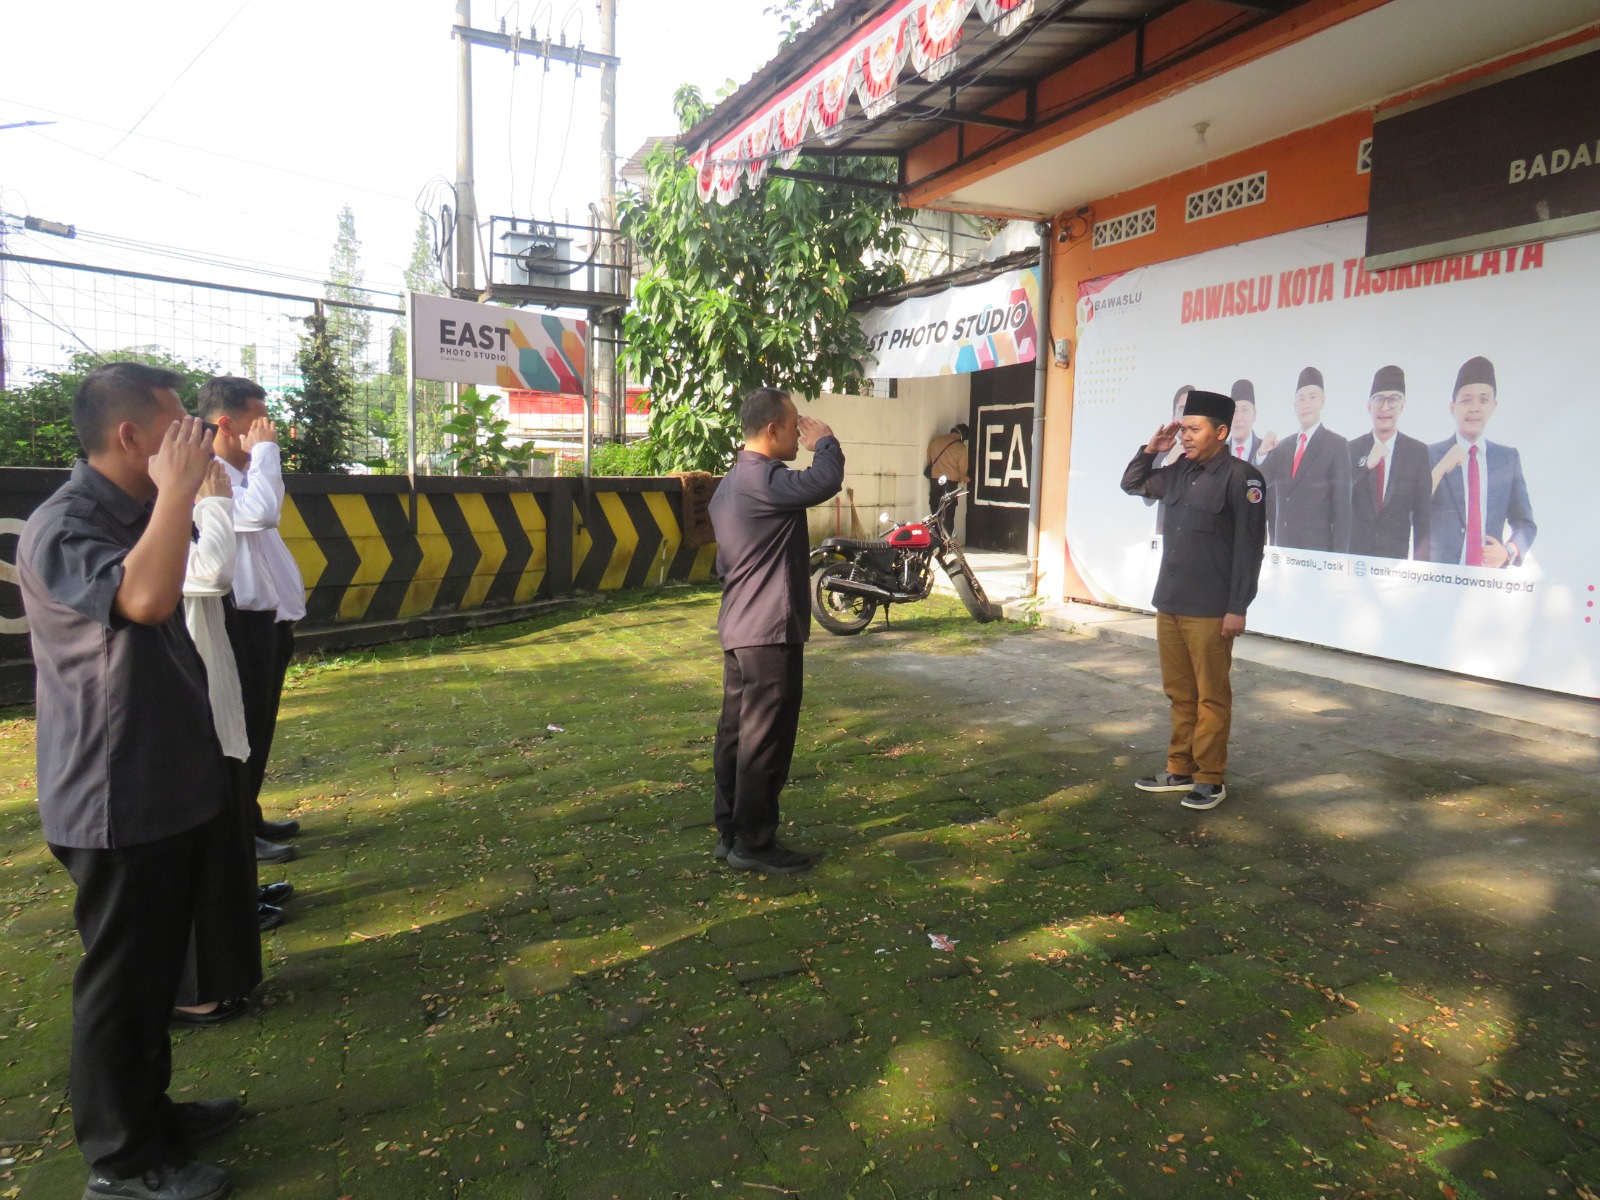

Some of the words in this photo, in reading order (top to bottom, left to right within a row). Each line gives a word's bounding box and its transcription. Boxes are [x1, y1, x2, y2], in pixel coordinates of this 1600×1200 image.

[1094, 292, 1142, 311] BAWASLU
[1181, 275, 1273, 324] BAWASLU
[1277, 262, 1334, 309] KOTA
[440, 319, 511, 351] EAST
[889, 320, 949, 350] PHOTO
[952, 302, 1027, 341] STUDIO
[440, 347, 471, 357] PHOTO
[473, 351, 506, 361] STUDIO
[984, 423, 1034, 488] EA
[1285, 556, 1344, 572] Bawaslu_Tasik
[1370, 566, 1534, 593] tasikmalayakota.bawaslu.go.id
